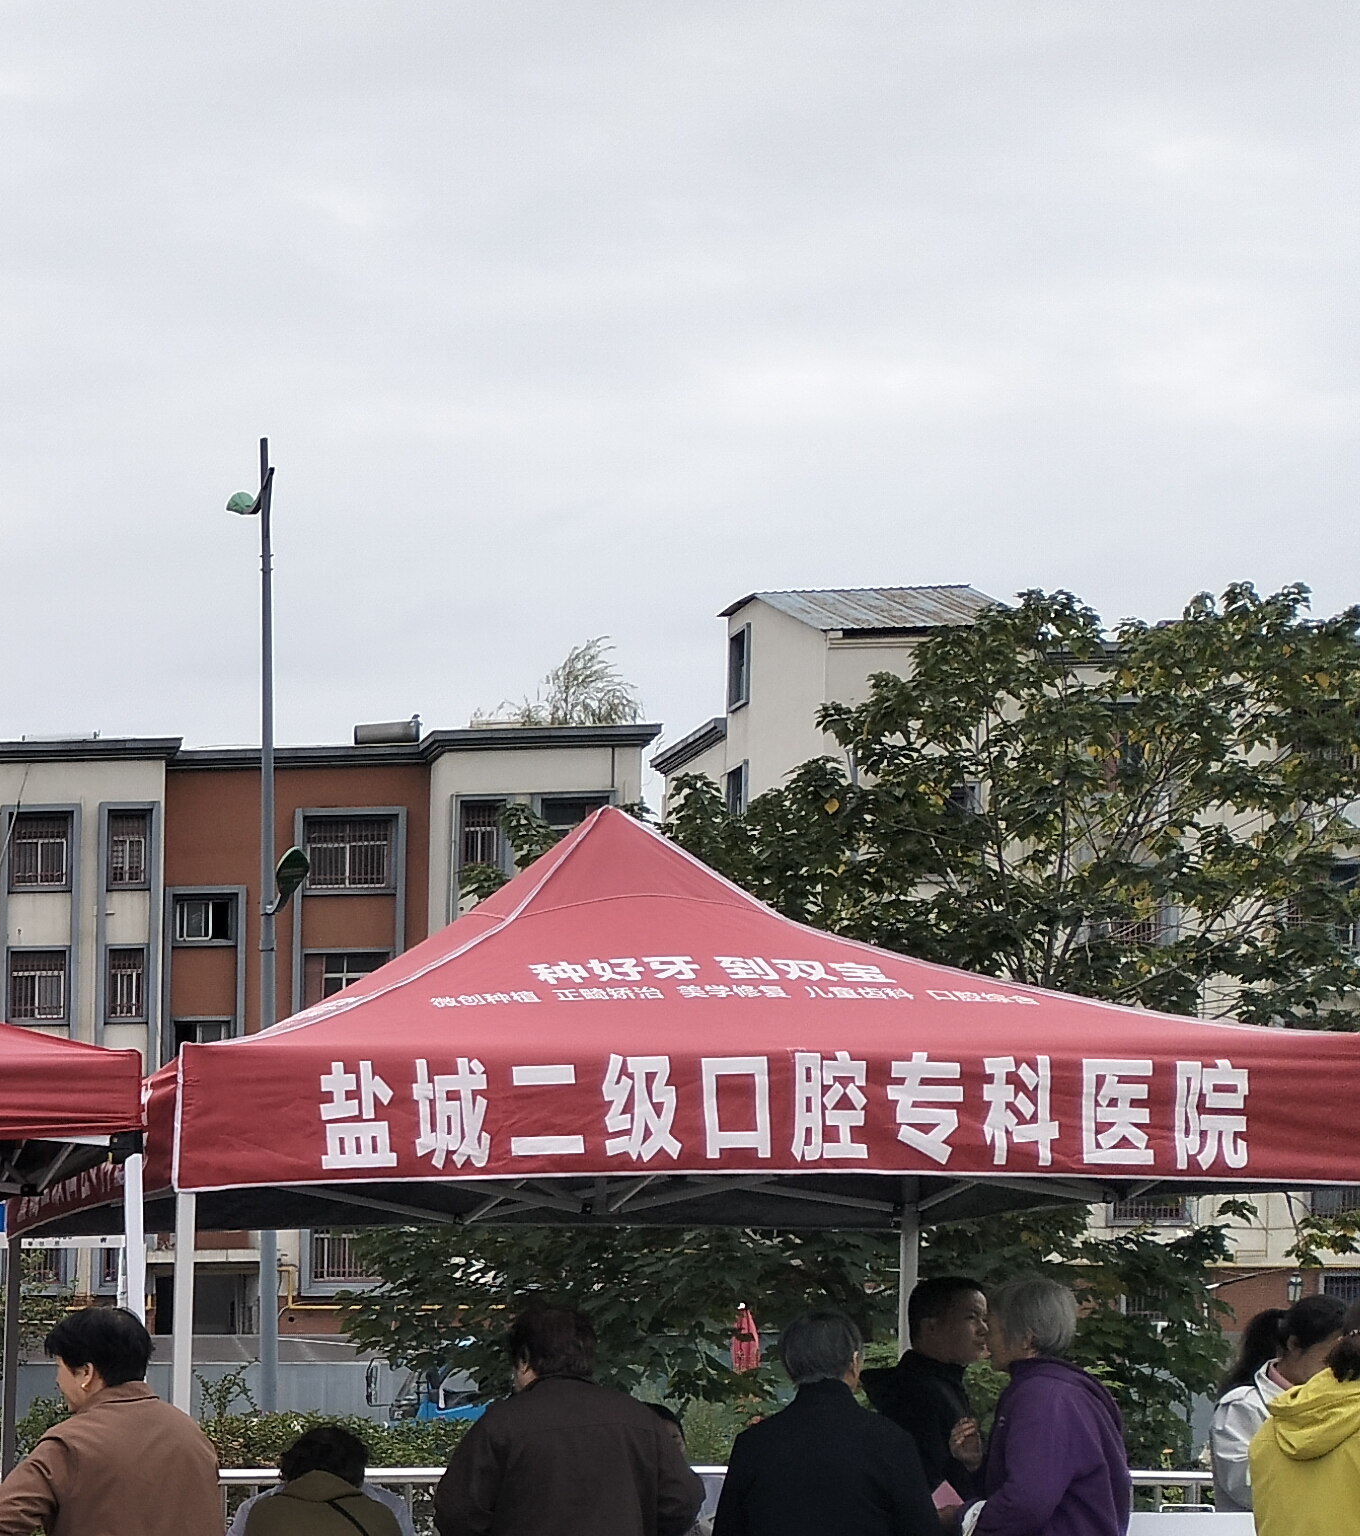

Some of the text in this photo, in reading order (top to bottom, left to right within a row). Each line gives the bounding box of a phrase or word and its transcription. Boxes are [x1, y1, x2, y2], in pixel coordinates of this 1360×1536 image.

[529, 956, 897, 985] 种好牙 到双宝
[319, 1051, 1251, 1171] 盐城二级口腔专科医院
